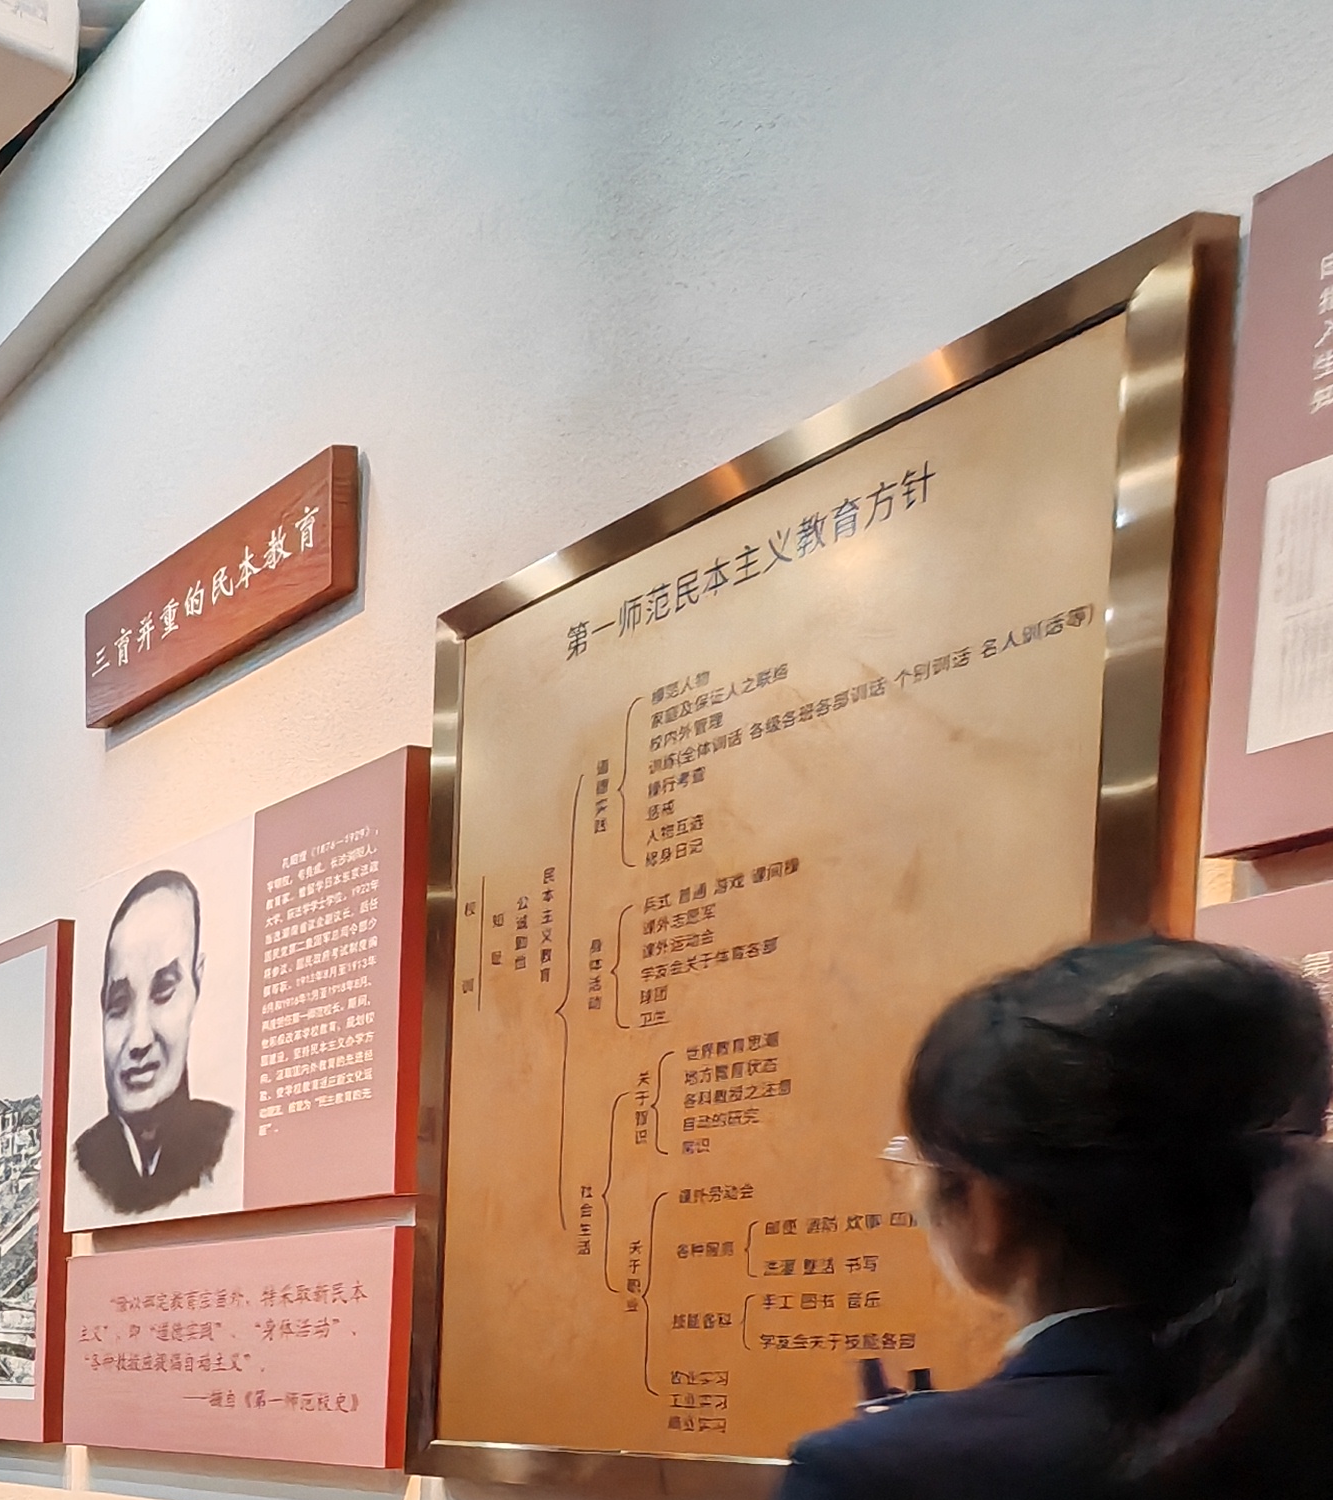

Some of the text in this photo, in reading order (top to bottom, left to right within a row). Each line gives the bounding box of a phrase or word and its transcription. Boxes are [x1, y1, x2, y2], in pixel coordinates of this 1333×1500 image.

[92, 506, 319, 678] 三育并重的民本教育
[566, 460, 936, 661] 第一师范民本主义教育方针
[540, 866, 555, 983] 民本主义教育
